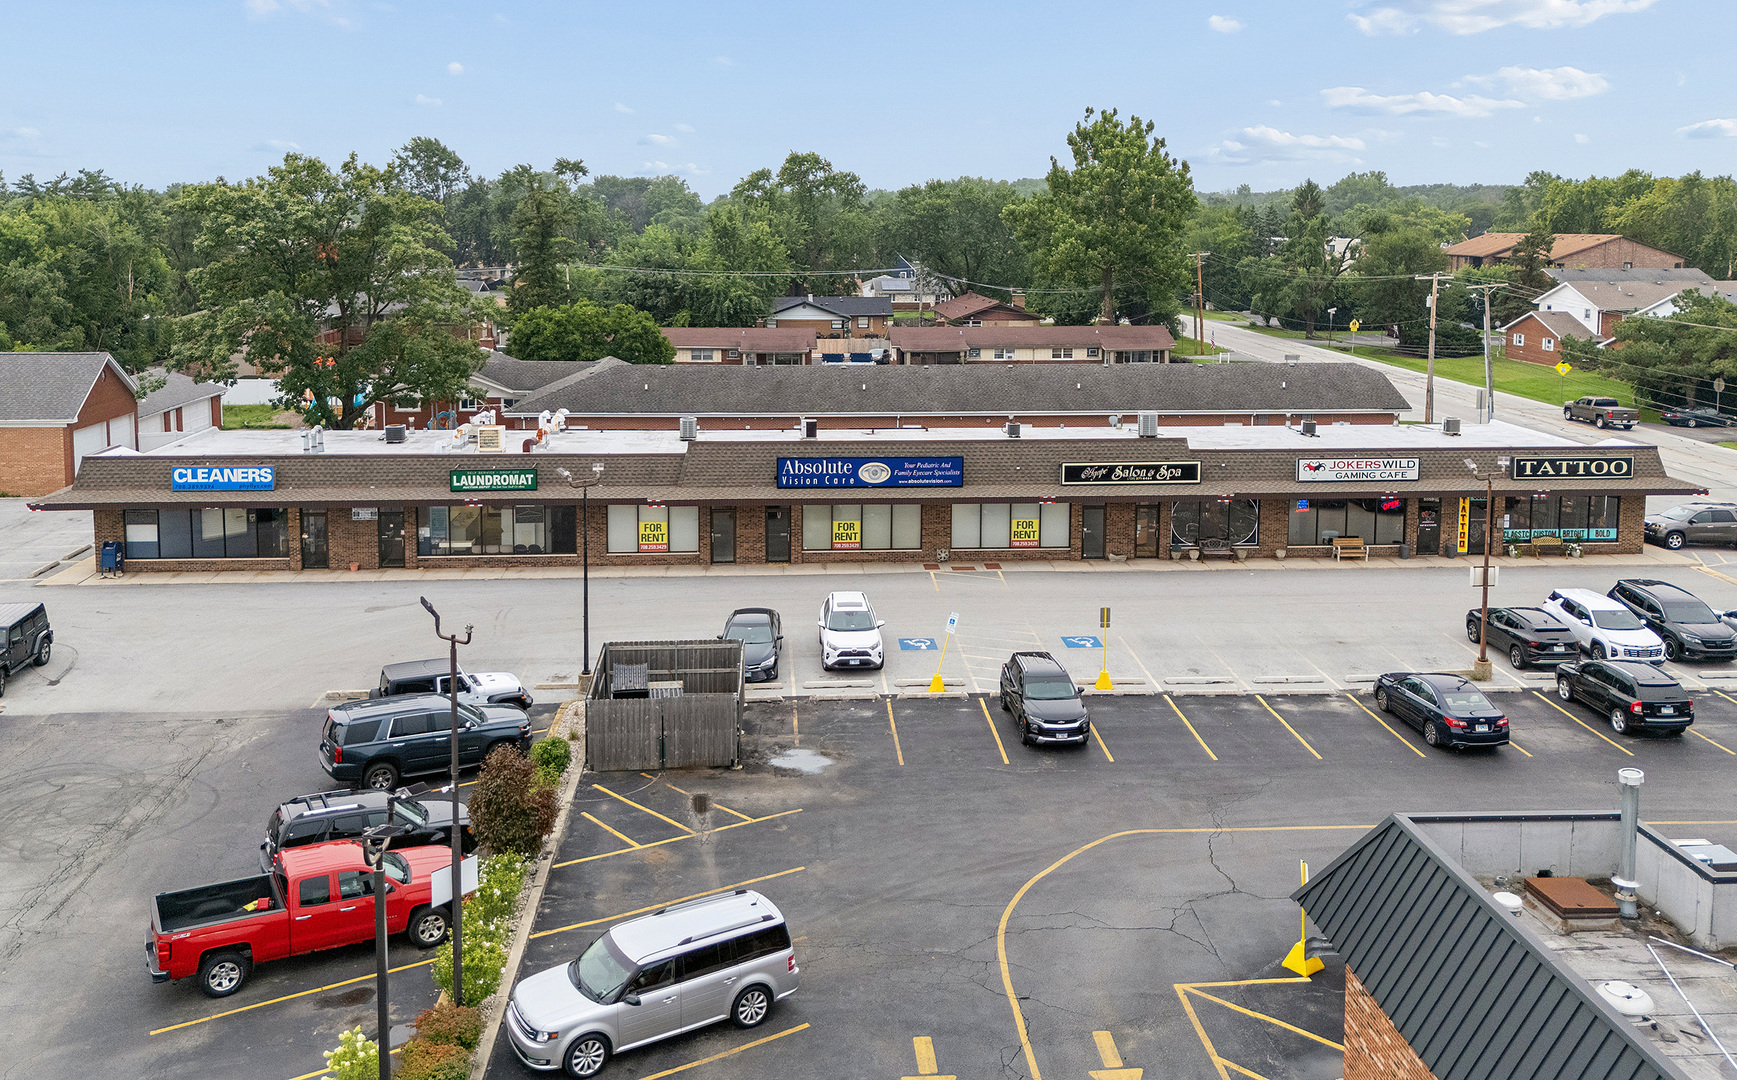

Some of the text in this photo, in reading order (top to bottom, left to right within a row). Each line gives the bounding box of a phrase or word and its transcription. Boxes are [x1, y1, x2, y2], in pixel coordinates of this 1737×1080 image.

[782, 460, 853, 475] Absolute
[1329, 460, 1416, 469] JOKERSWILD
[1520, 460, 1628, 475] TATTOO
[173, 468, 273, 483] CLEANERS
[1111, 465, 1146, 480] Salon
[1156, 465, 1182, 480] Spa
[1335, 471, 1408, 479] GAMING CAFE
[453, 474, 534, 486] LAUNDROMAT
[782, 475, 855, 485] Vision Care
[1382, 499, 1400, 511] OPEN
[837, 522, 856, 531] FOR
[1016, 520, 1034, 530] FOR
[1459, 496, 1467, 548] TATTOO
[644, 523, 662, 532] FOR
[641, 533, 666, 542] RENT
[834, 532, 859, 541] RENT
[1013, 530, 1038, 539] RENT
[1503, 529, 1611, 539] CLASSIC CUSTOM BRIGHT BOLD
